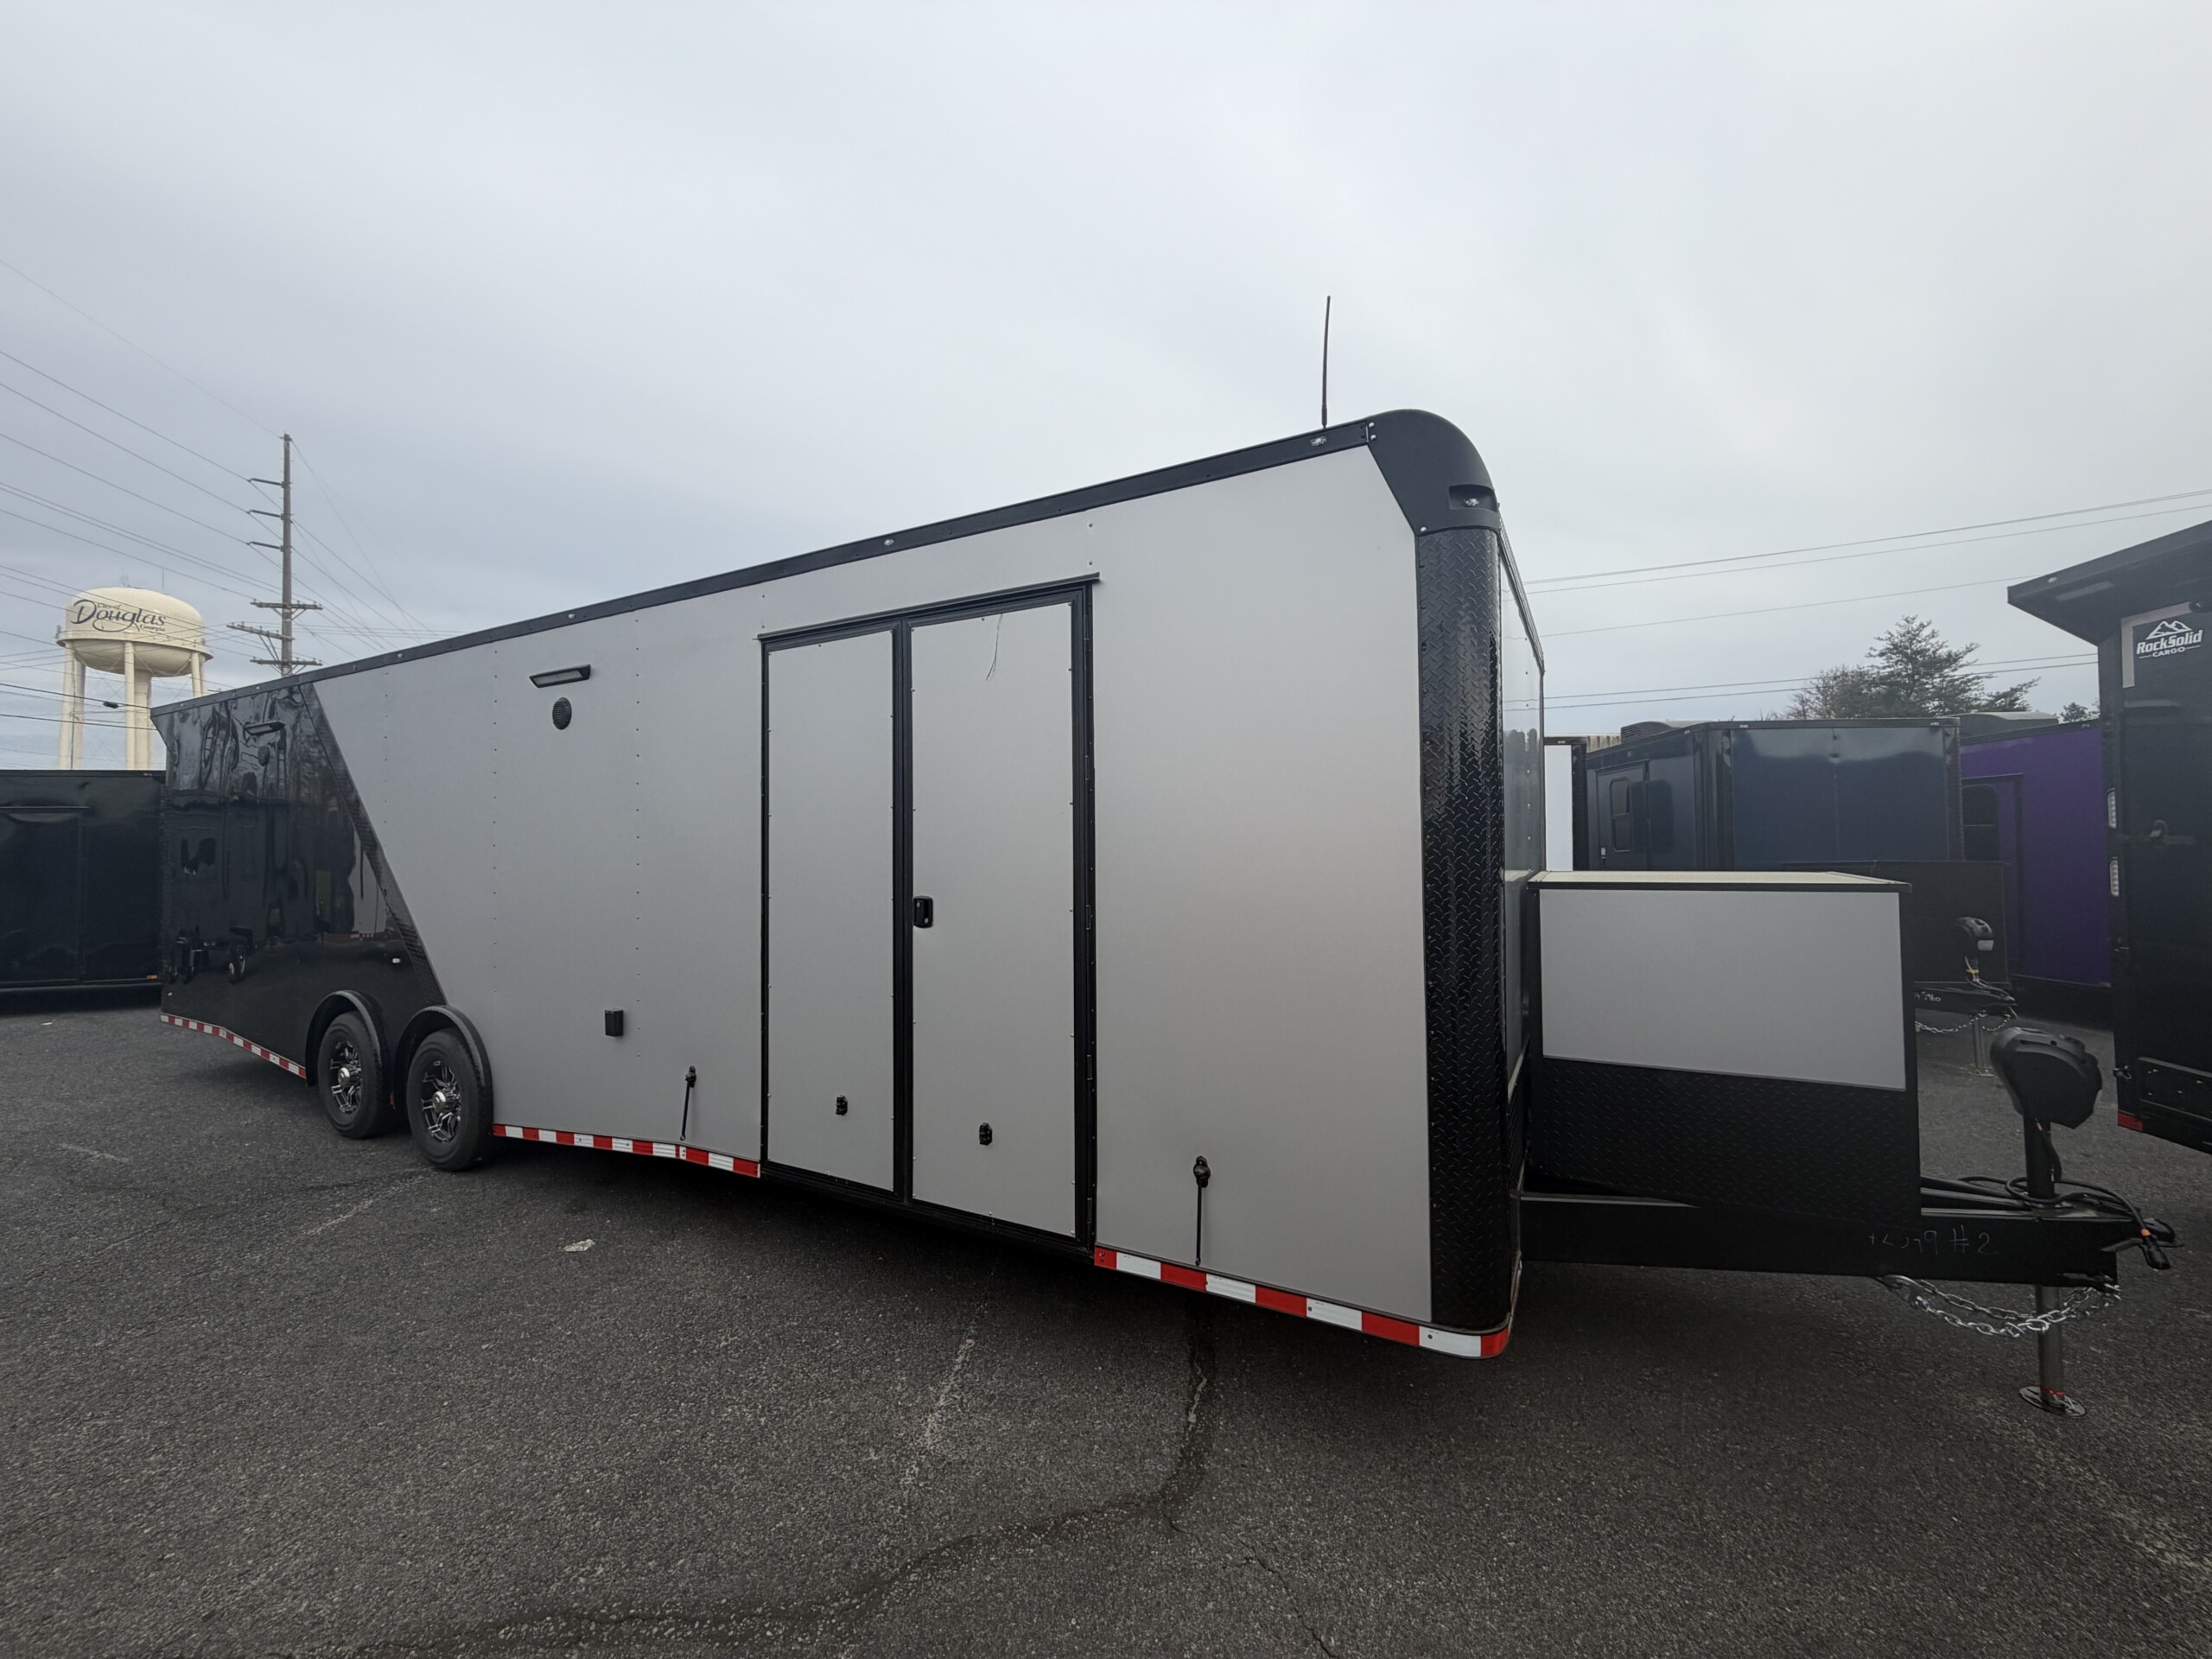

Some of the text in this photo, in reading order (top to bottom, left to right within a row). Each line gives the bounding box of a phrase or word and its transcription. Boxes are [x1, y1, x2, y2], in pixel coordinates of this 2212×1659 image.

[70, 599, 167, 632] Douglas
[2136, 629, 2203, 655] RockSolid
[2152, 646, 2186, 658] CARGO
